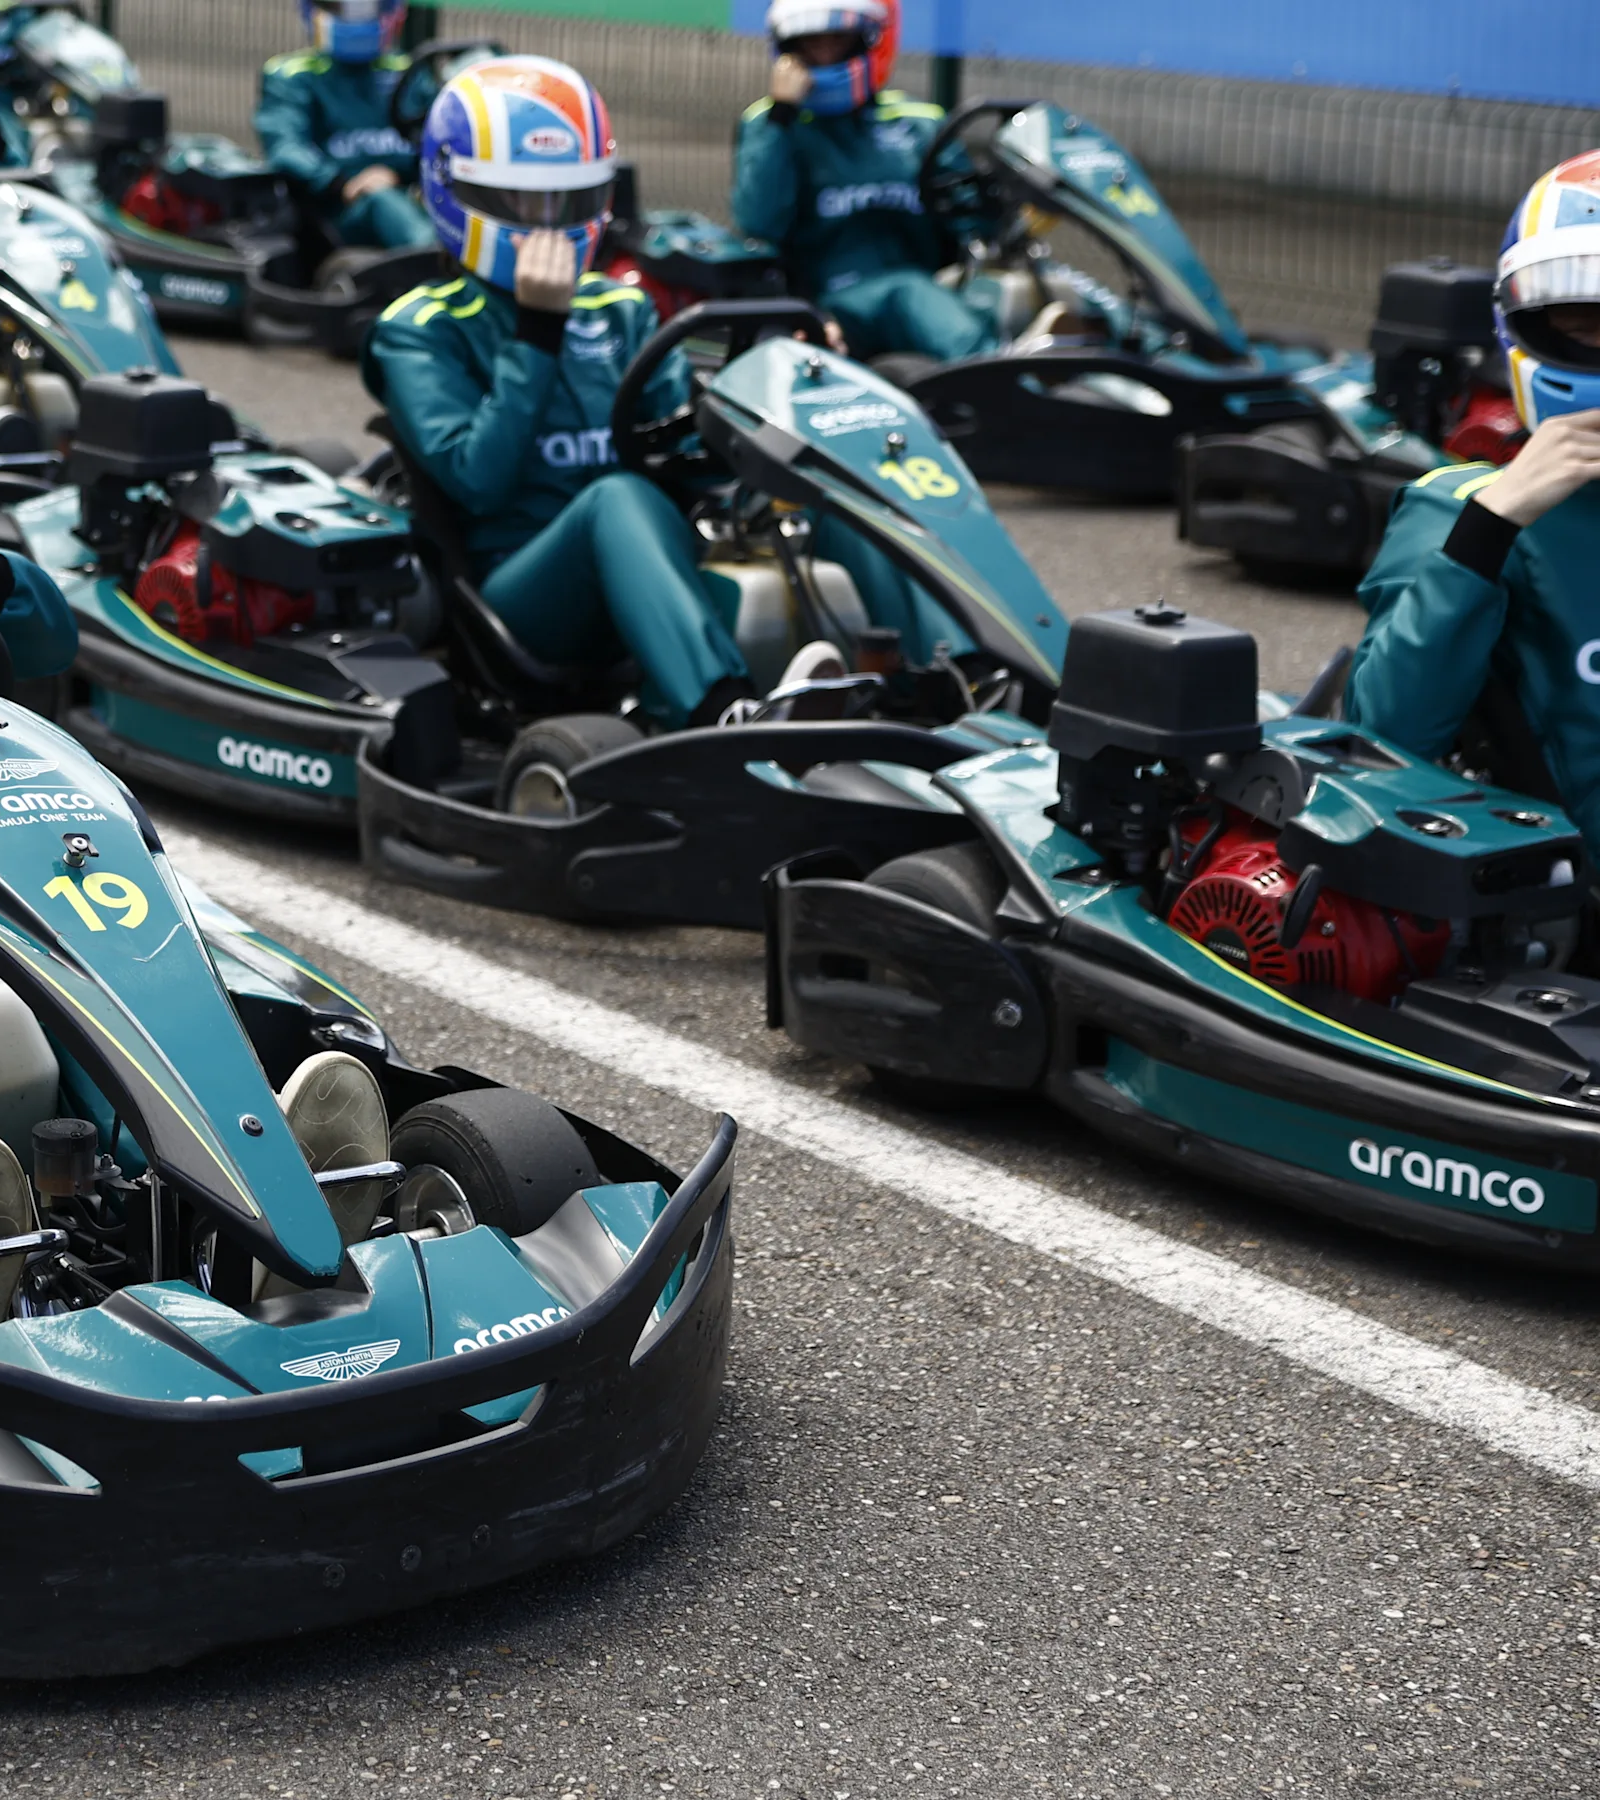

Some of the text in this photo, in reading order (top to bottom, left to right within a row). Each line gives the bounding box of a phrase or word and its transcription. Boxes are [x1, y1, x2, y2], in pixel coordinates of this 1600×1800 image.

[877, 456, 960, 500] 18
[217, 736, 333, 788] aramco
[70, 812, 108, 822] TEAM
[42, 872, 149, 931] 19
[1349, 1138, 1546, 1215] aramco
[320, 1350, 371, 1370] ASTON MARTIN
